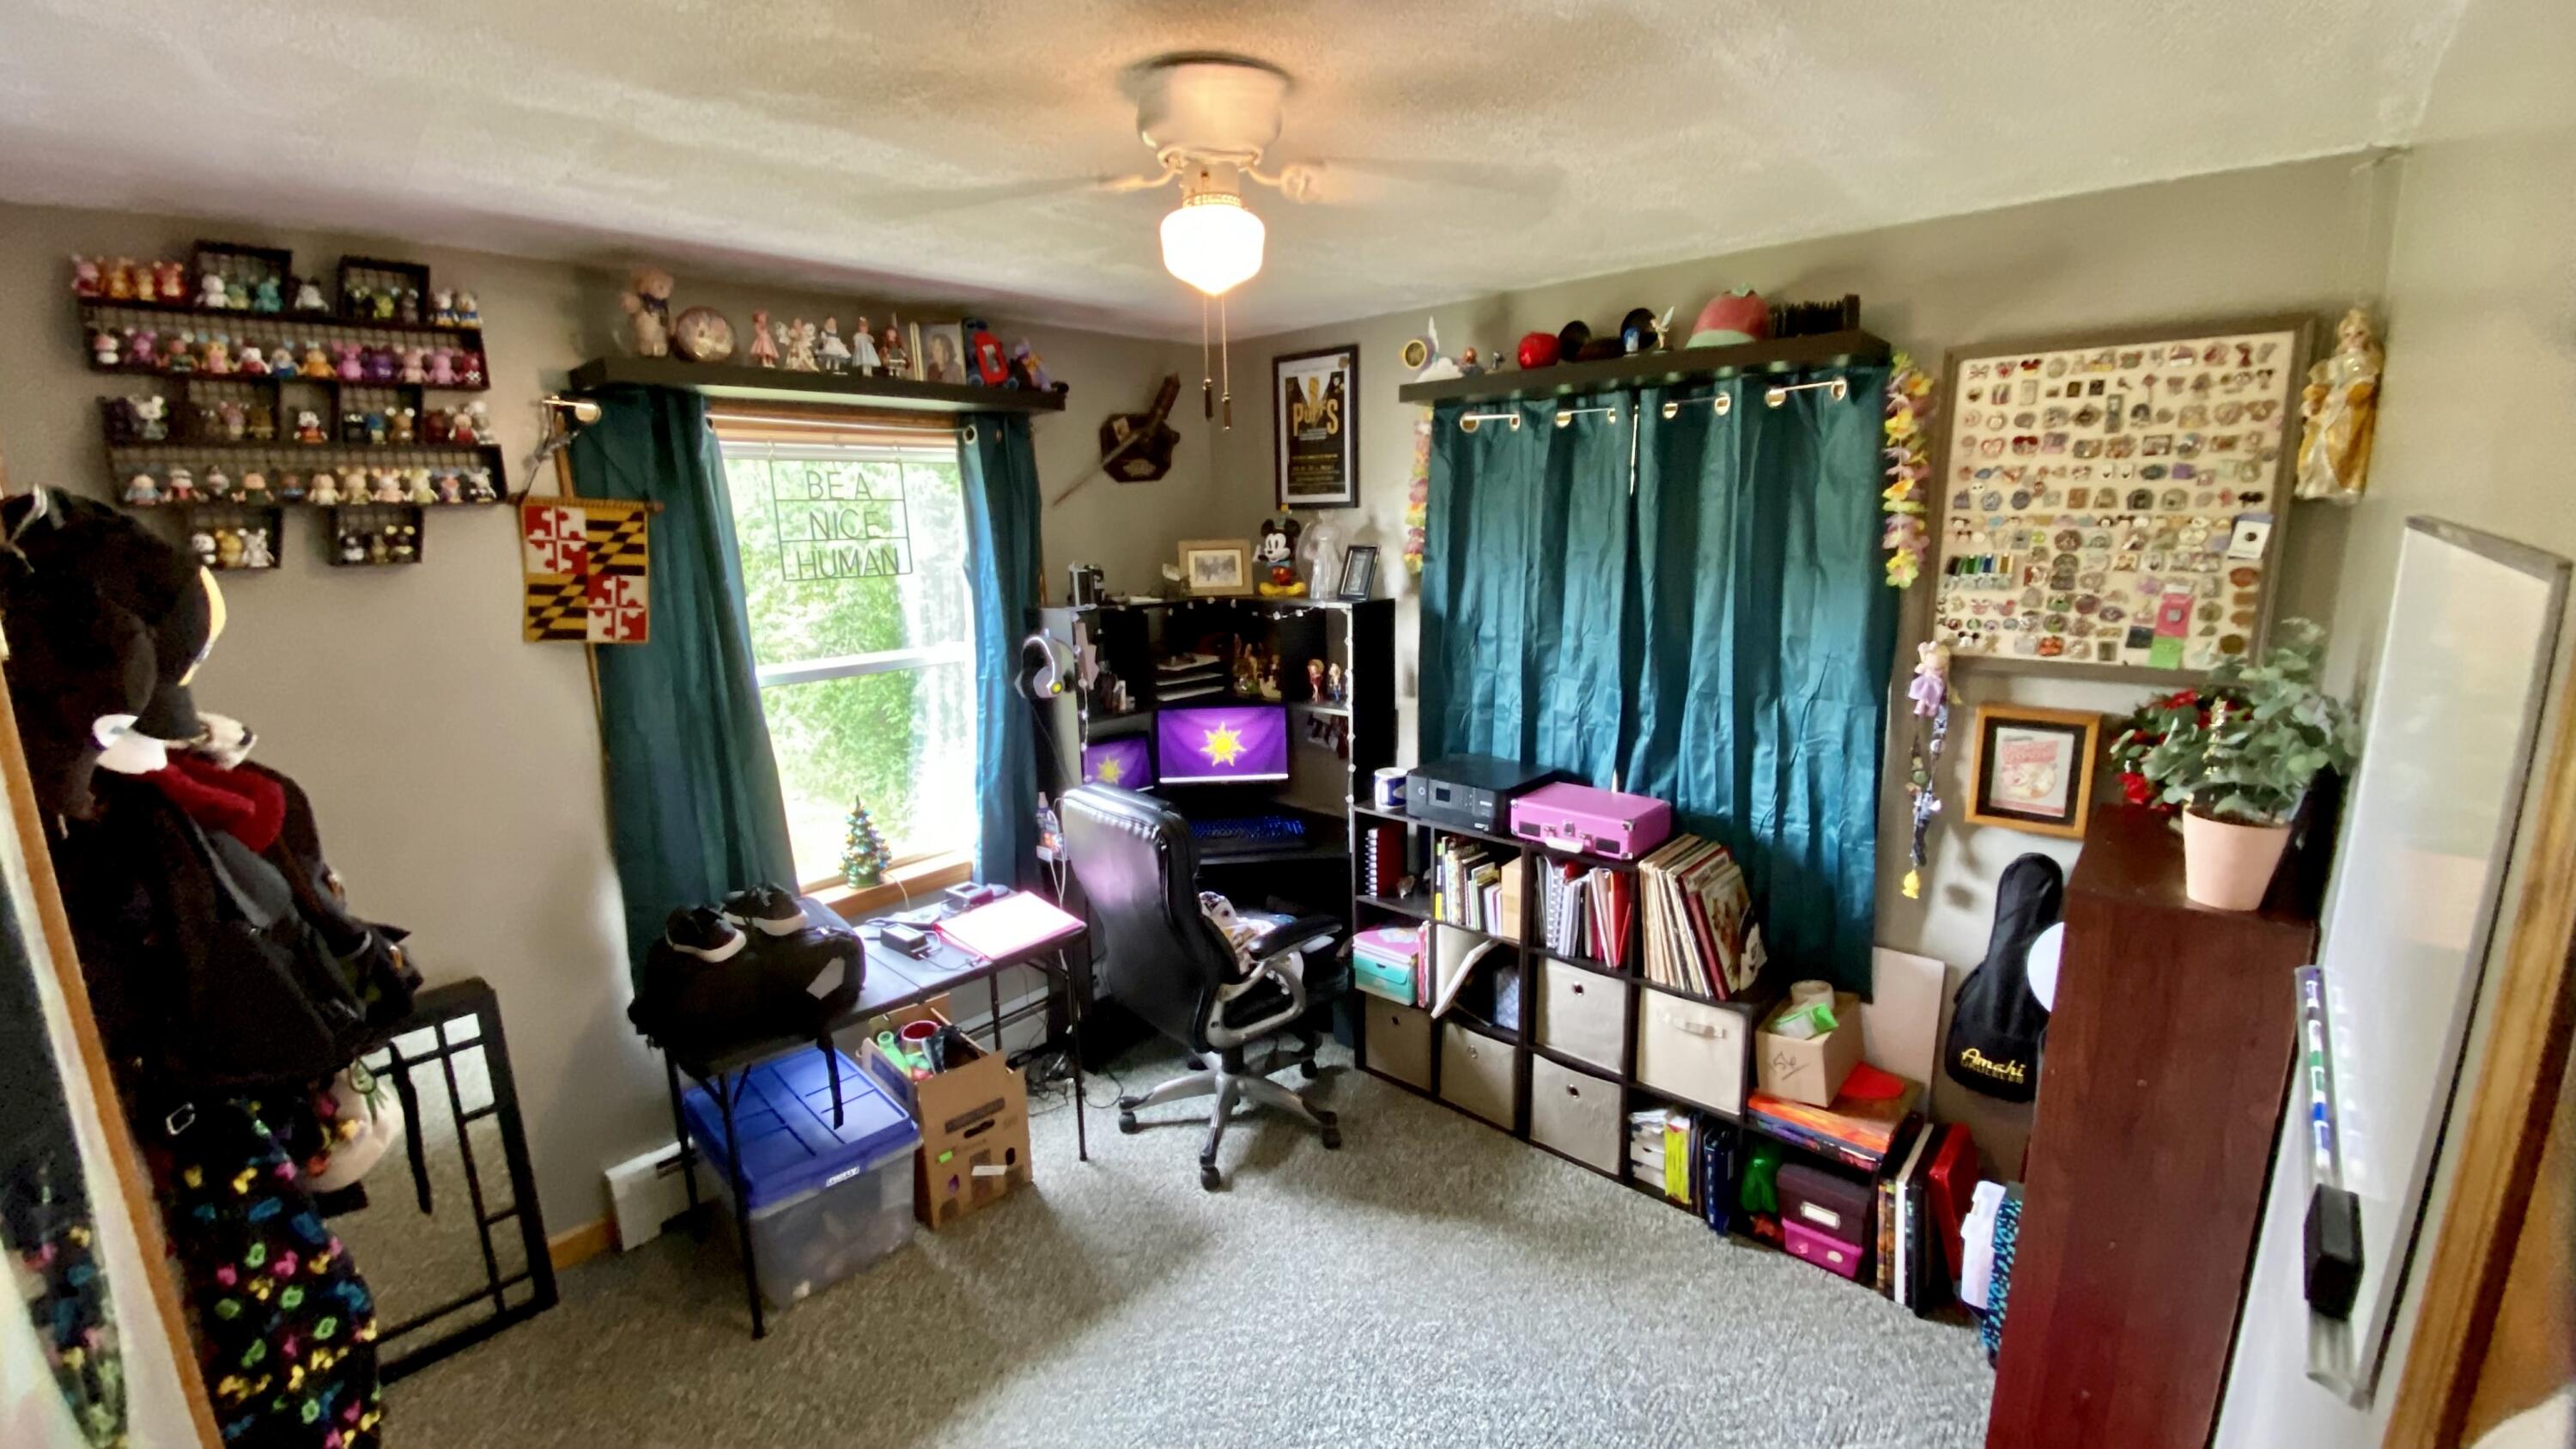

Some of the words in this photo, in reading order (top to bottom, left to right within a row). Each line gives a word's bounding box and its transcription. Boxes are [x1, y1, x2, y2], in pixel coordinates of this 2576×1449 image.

[806, 470, 844, 501] BE
[854, 472, 873, 502] A
[810, 508, 881, 540] NICE
[796, 546, 899, 581] HUMAN
